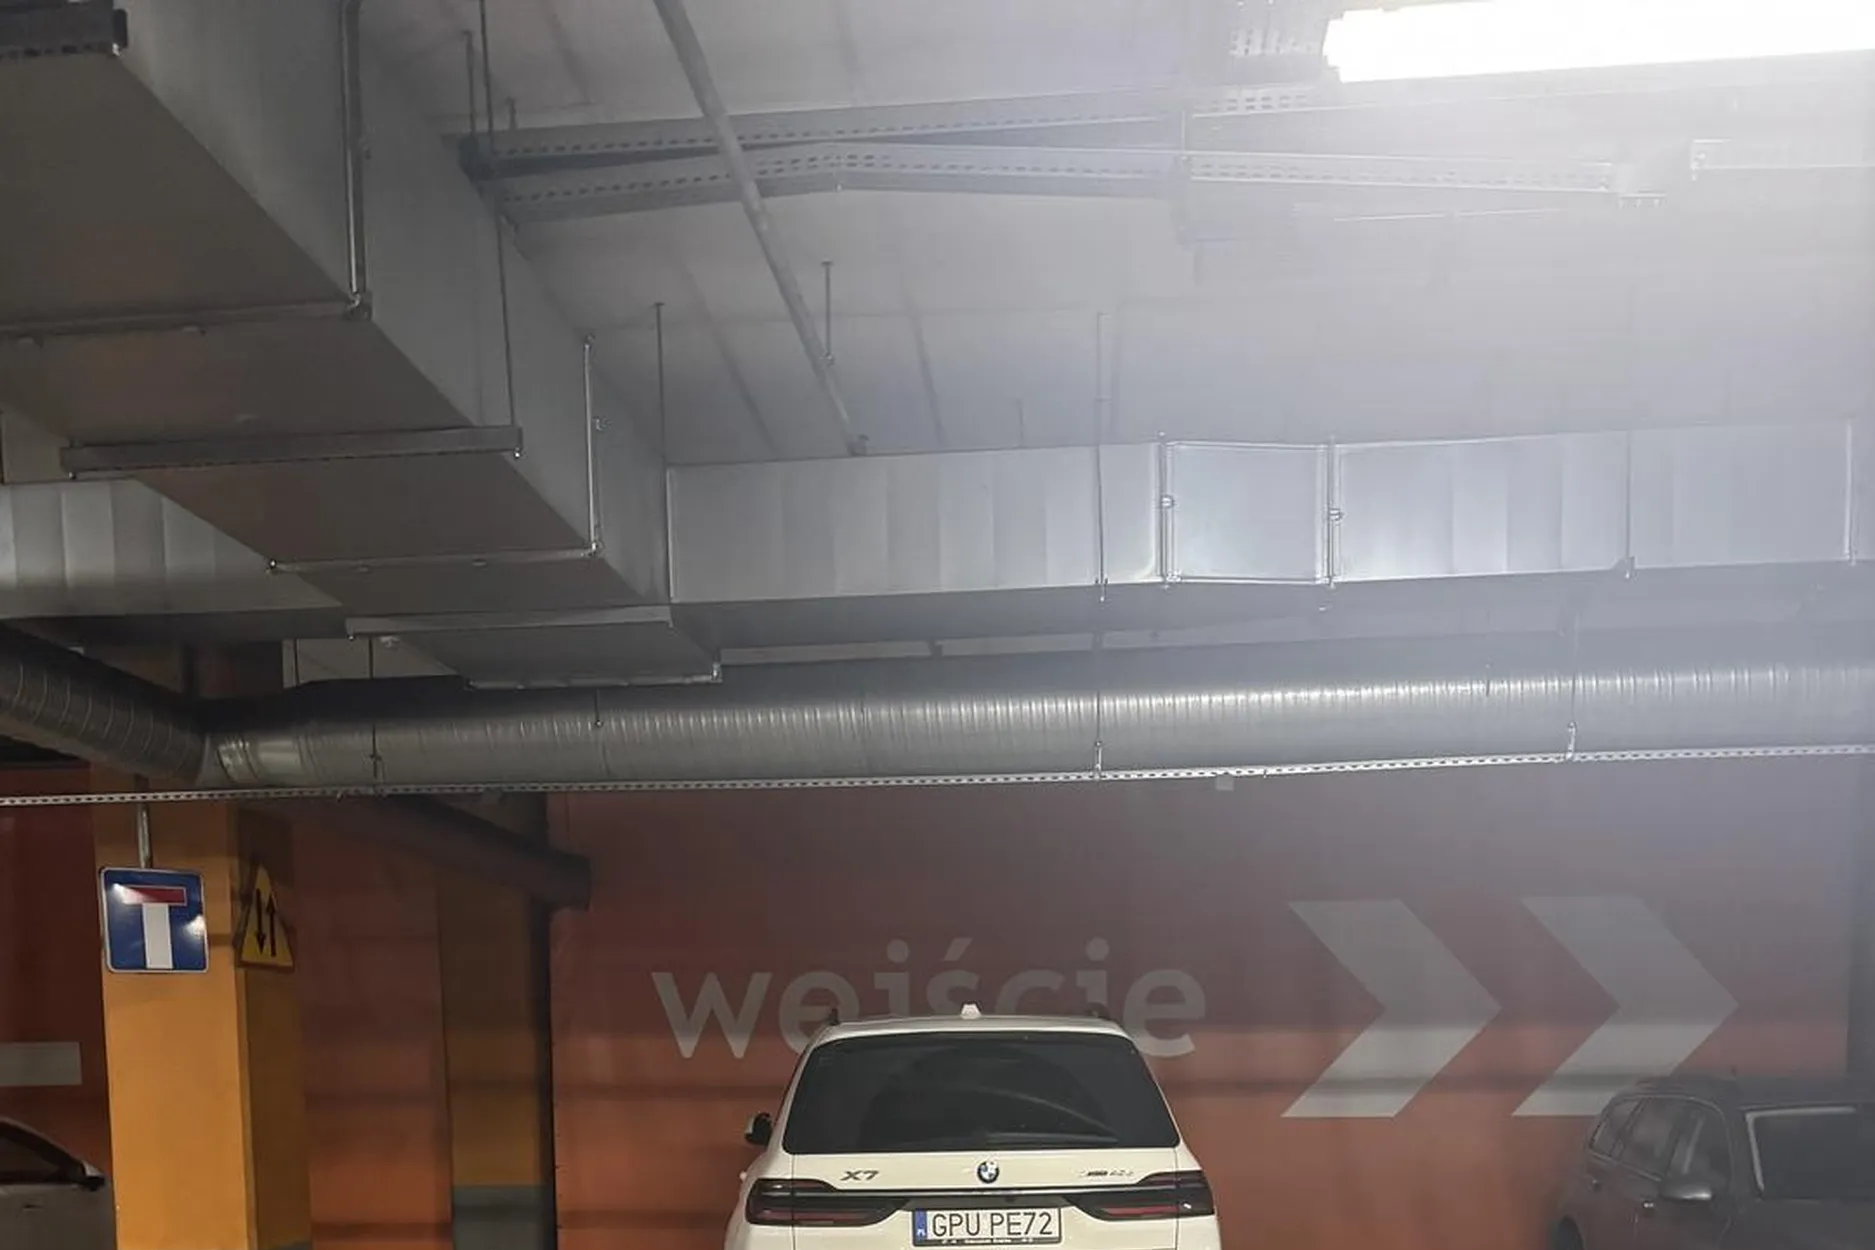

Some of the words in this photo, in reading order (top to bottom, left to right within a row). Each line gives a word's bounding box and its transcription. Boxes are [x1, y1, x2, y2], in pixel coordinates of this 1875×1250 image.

[839, 1169, 879, 1181] X7
[932, 1212, 981, 1237] GPU
[990, 1211, 1053, 1236] PE72
